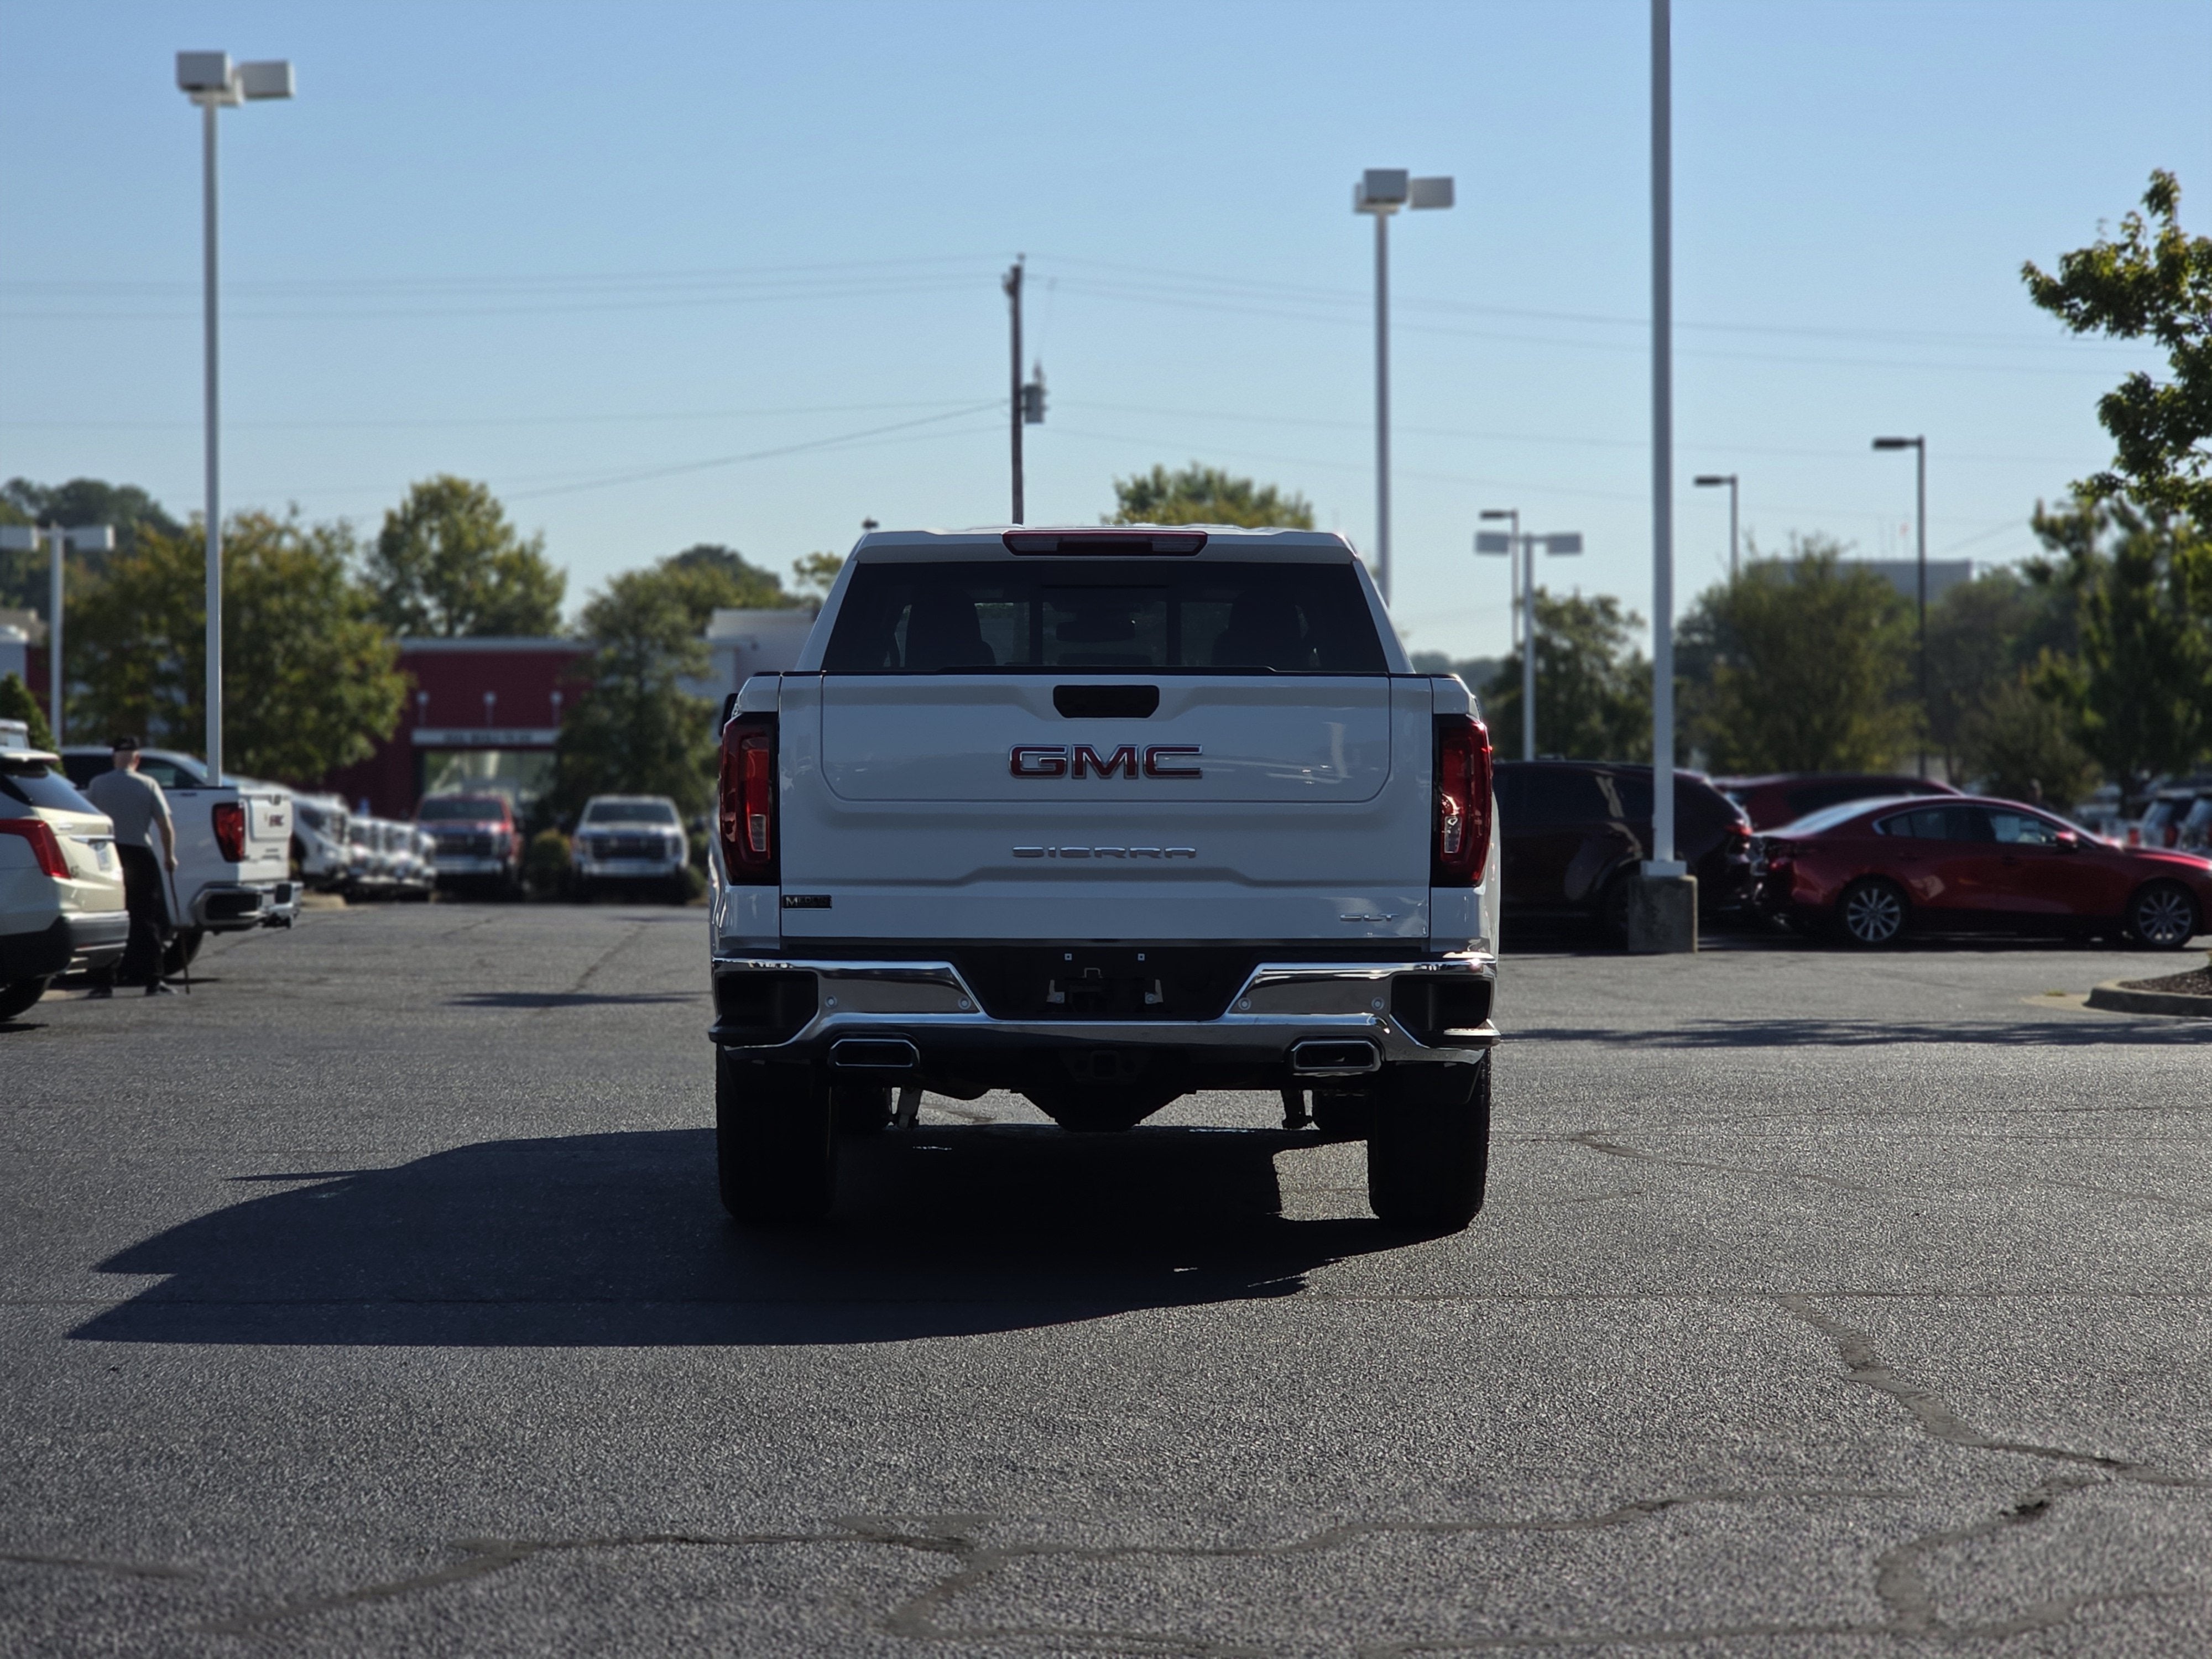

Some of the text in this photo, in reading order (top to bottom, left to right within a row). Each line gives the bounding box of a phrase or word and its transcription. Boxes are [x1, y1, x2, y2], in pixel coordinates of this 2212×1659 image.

[1009, 744, 1202, 779] GMC
[1013, 846, 1196, 858] SIERRA
[1340, 913, 1400, 922] SLT
